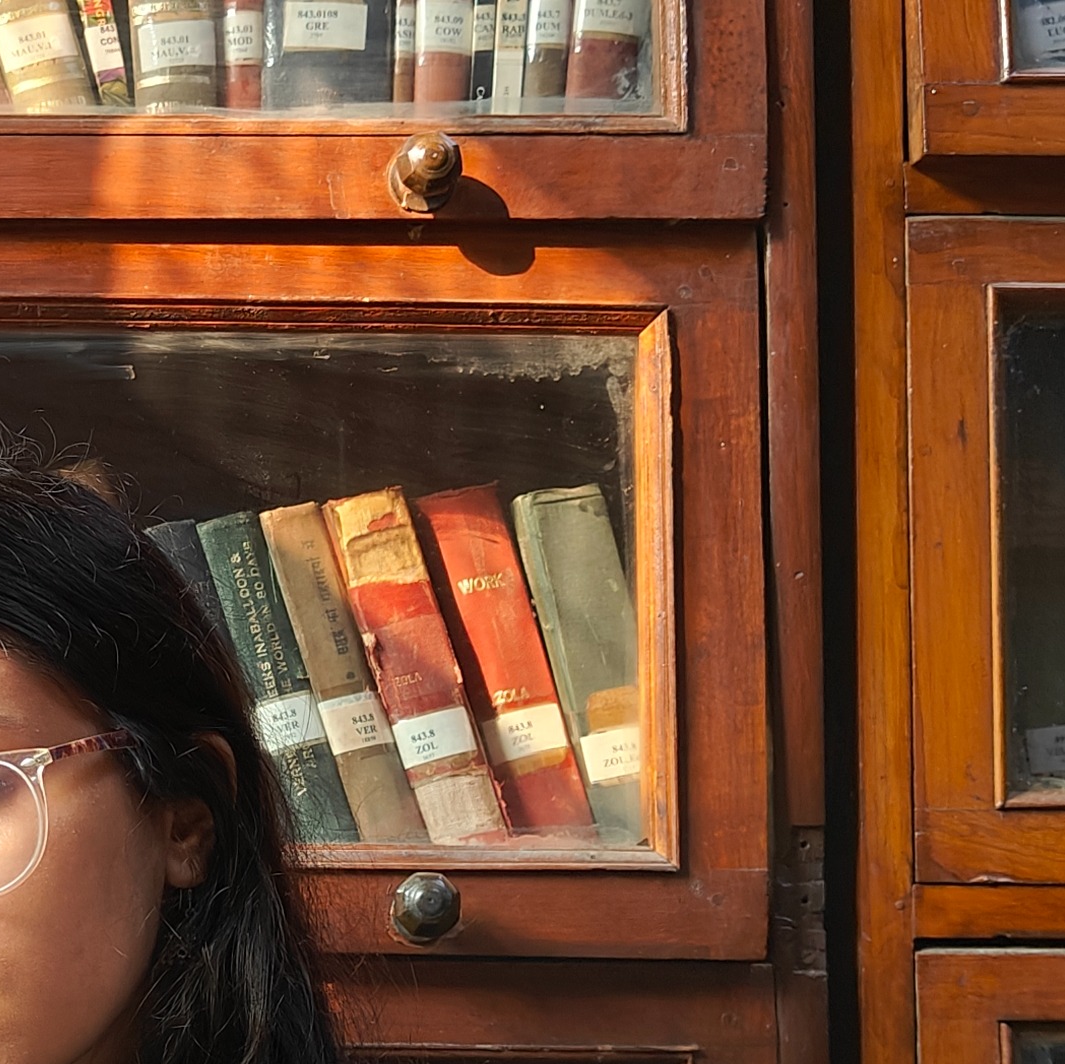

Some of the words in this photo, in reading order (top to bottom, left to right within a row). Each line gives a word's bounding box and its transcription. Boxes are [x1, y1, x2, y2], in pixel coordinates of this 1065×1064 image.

[100, 26, 115, 34] 843
[305, 22, 329, 31] GRE
[435, 27, 462, 36] COW
[536, 22, 561, 31] DUM
[255, 578, 268, 602] 80
[266, 620, 288, 673] WORLD
[257, 662, 279, 699] EEKS
[493, 686, 530, 704] ZOLA
[351, 713, 375, 725] 843.8
[355, 724, 378, 736] VER
[410, 729, 436, 744] 843.8
[511, 732, 535, 745] ZOL
[415, 741, 439, 755] ZOL
